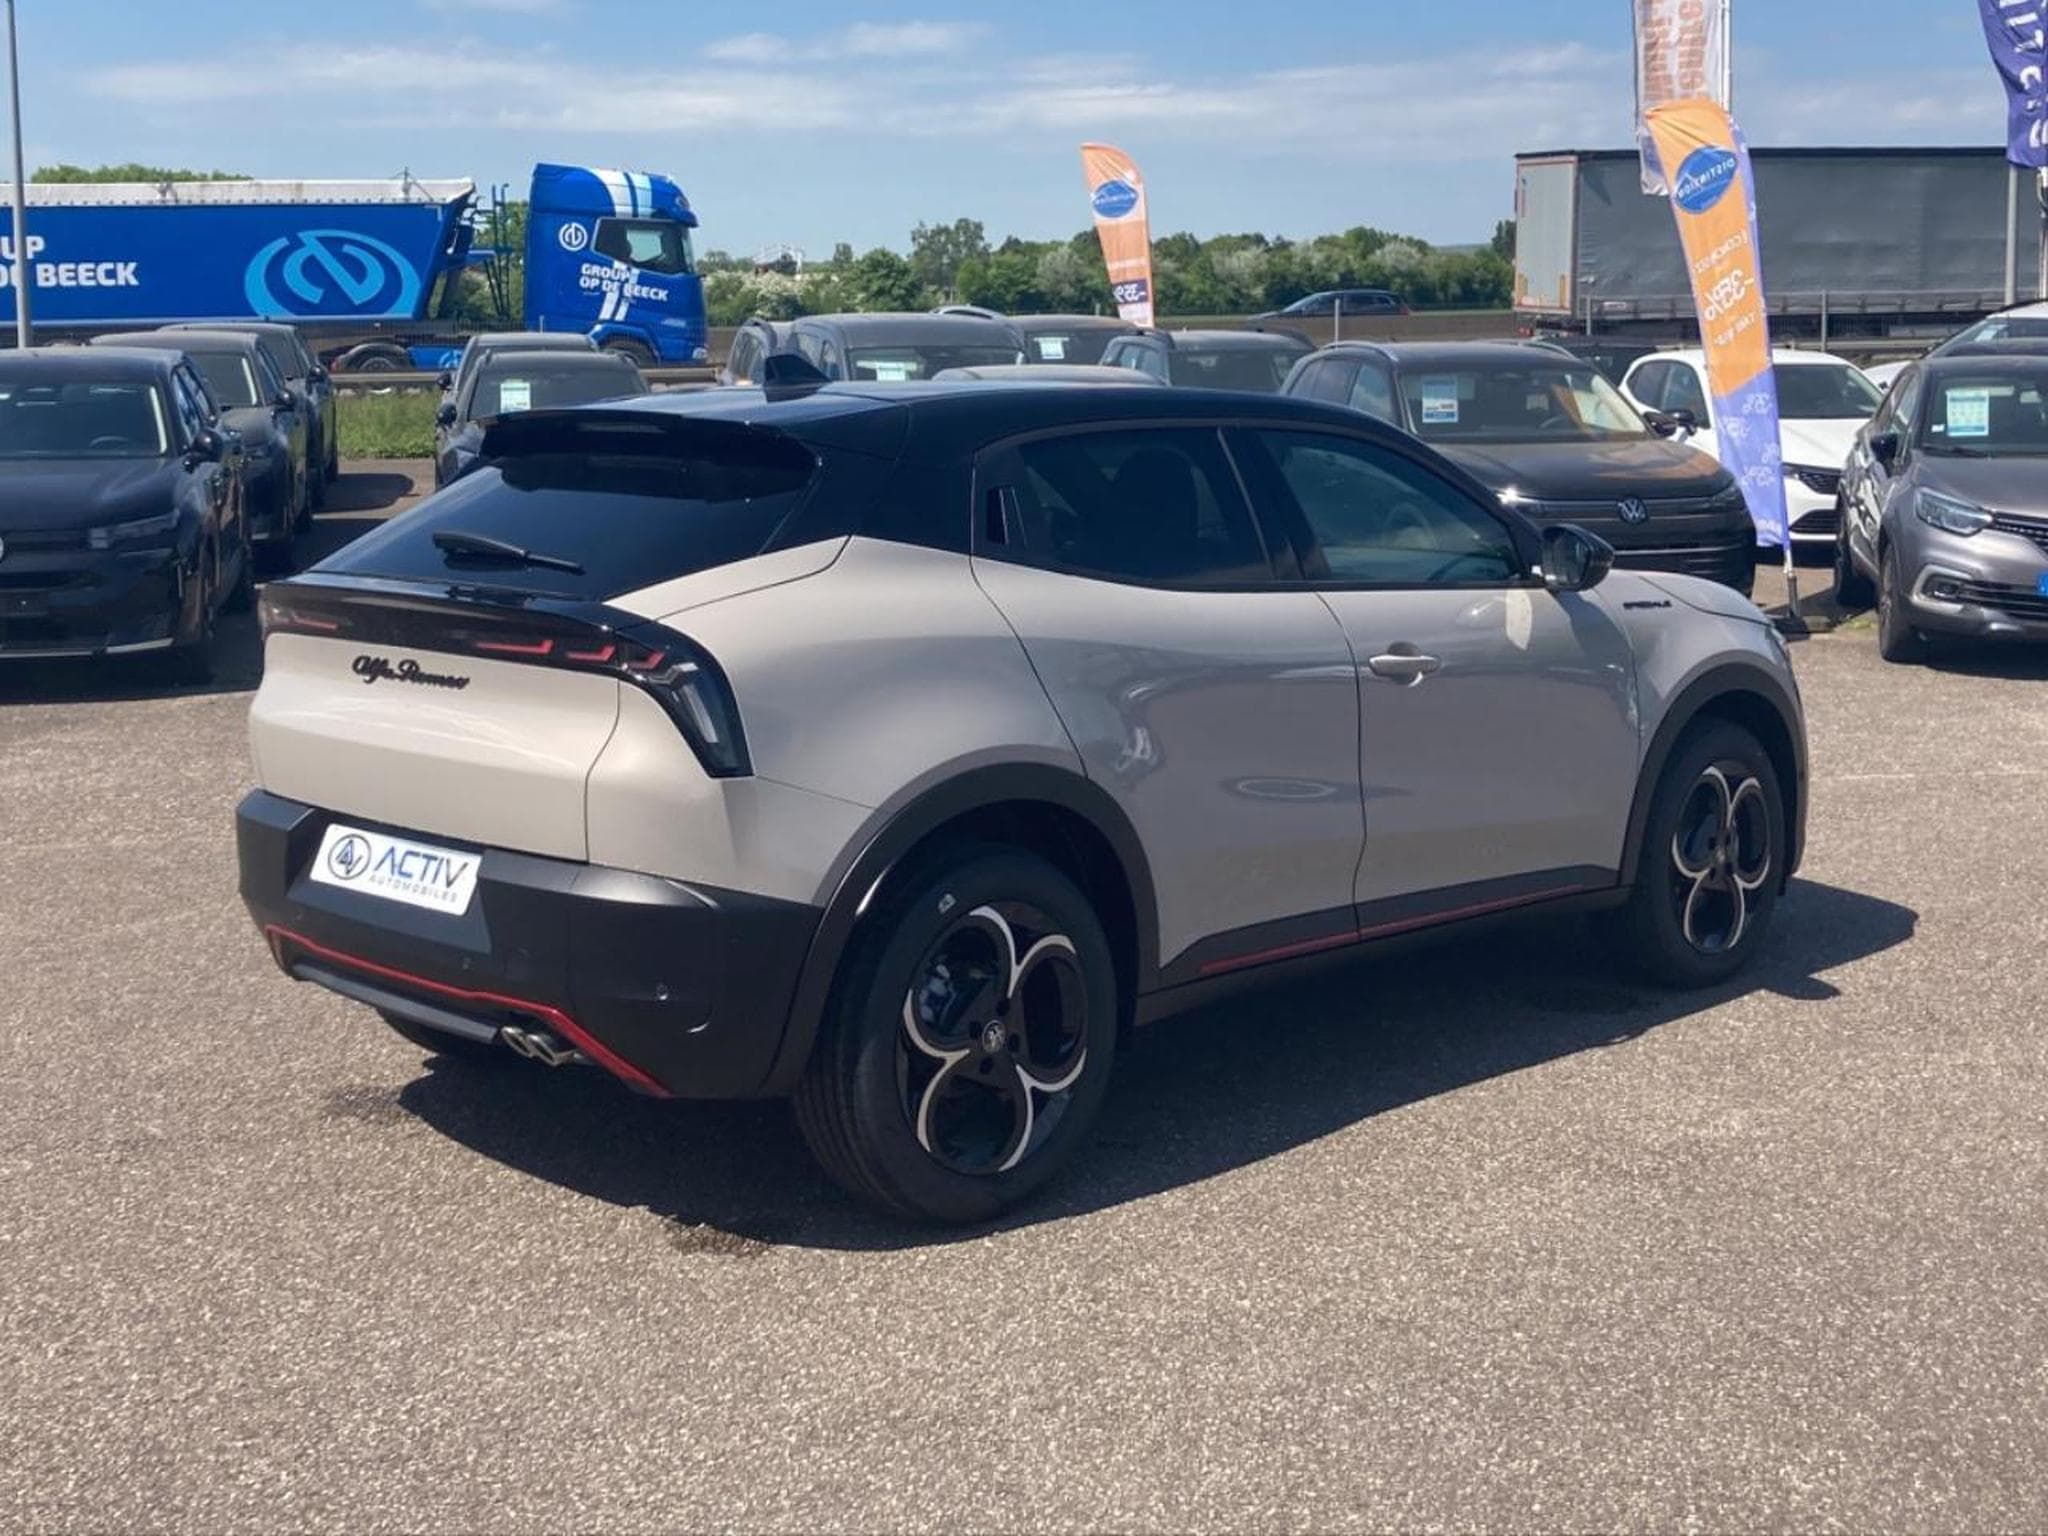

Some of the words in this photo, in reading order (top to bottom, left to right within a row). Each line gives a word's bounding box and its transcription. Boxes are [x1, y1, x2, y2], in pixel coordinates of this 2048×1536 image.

[36, 262, 139, 287] BEECK
[581, 263, 630, 281] GROUP
[580, 276, 600, 289] OP
[623, 282, 669, 301] BEECK
[352, 655, 395, 684] Alfa
[397, 659, 470, 689] Romeo
[374, 846, 469, 888] ACTIV
[369, 874, 458, 903] AUTOMOBILES
